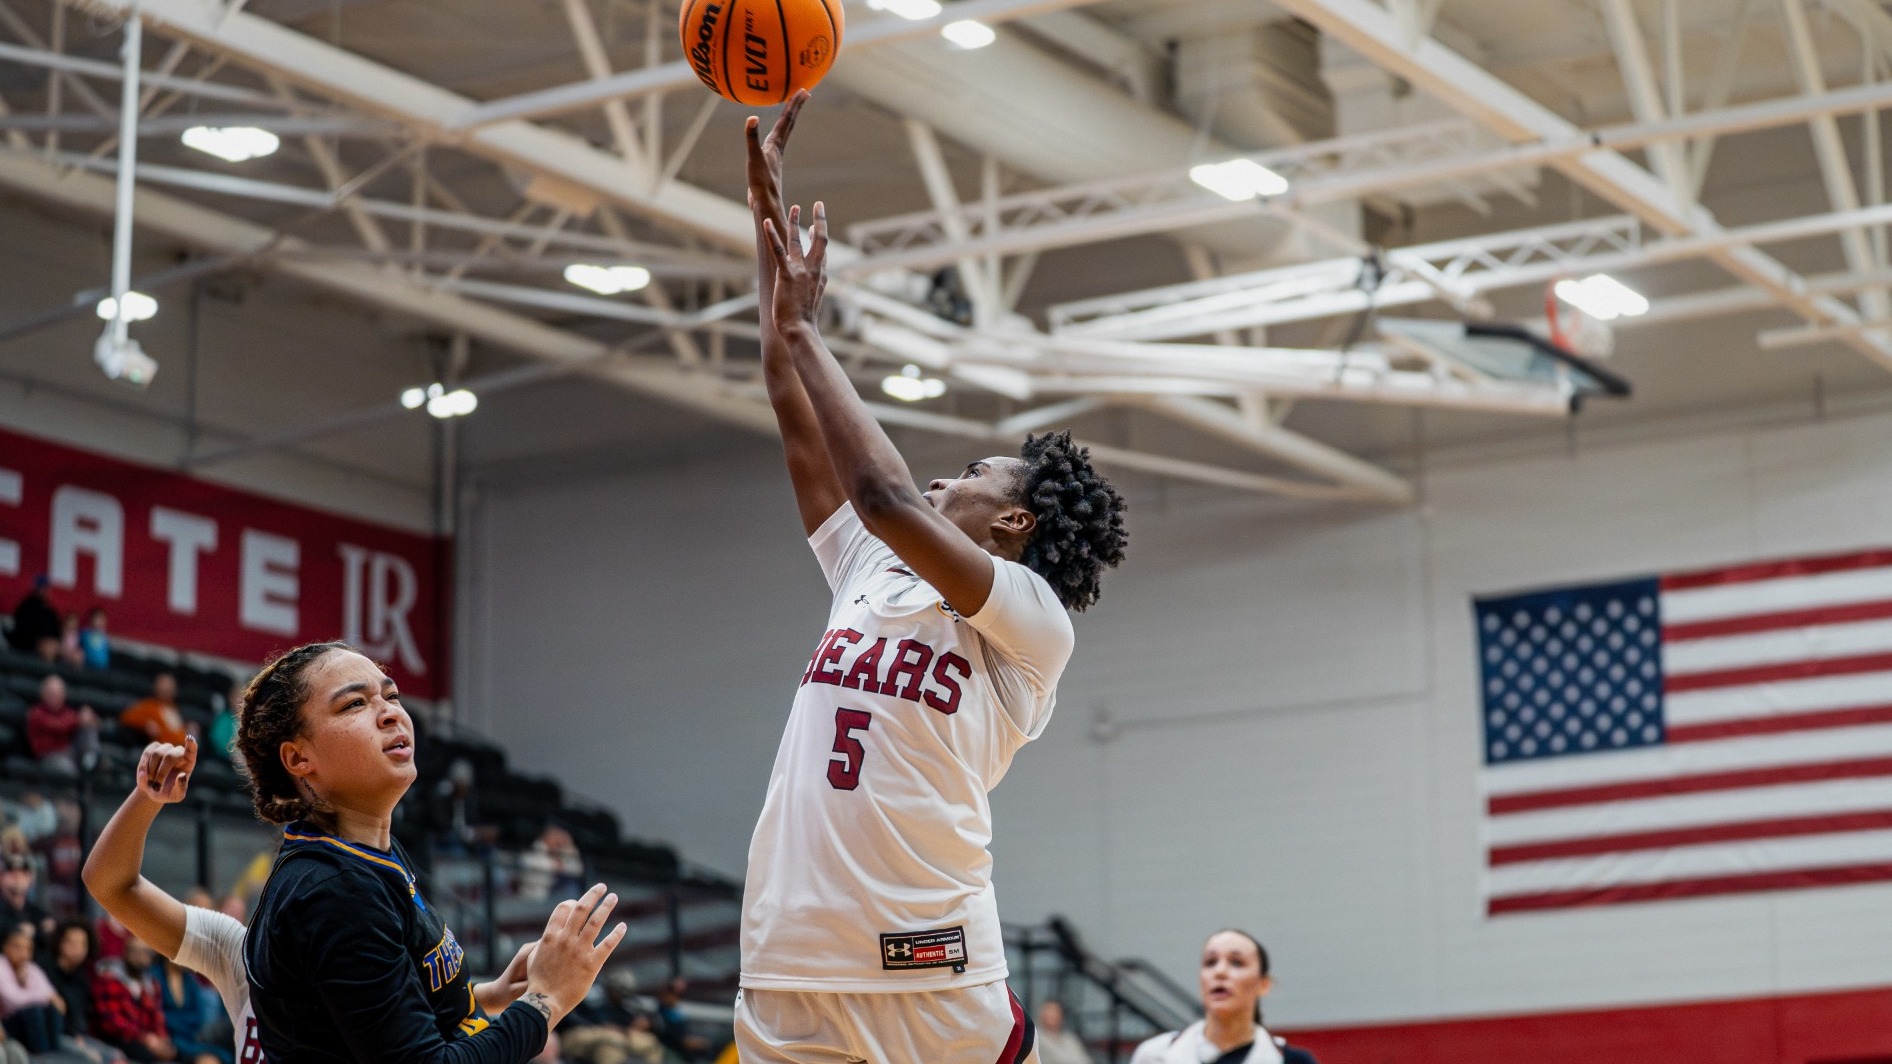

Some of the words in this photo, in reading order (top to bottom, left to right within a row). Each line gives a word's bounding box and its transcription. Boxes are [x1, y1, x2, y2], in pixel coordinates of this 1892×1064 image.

[744, 32, 769, 92] EVO
[827, 707, 872, 791] 5
[915, 950, 945, 959] AUTHENTIC
[936, 935, 960, 943] ARMOUR
